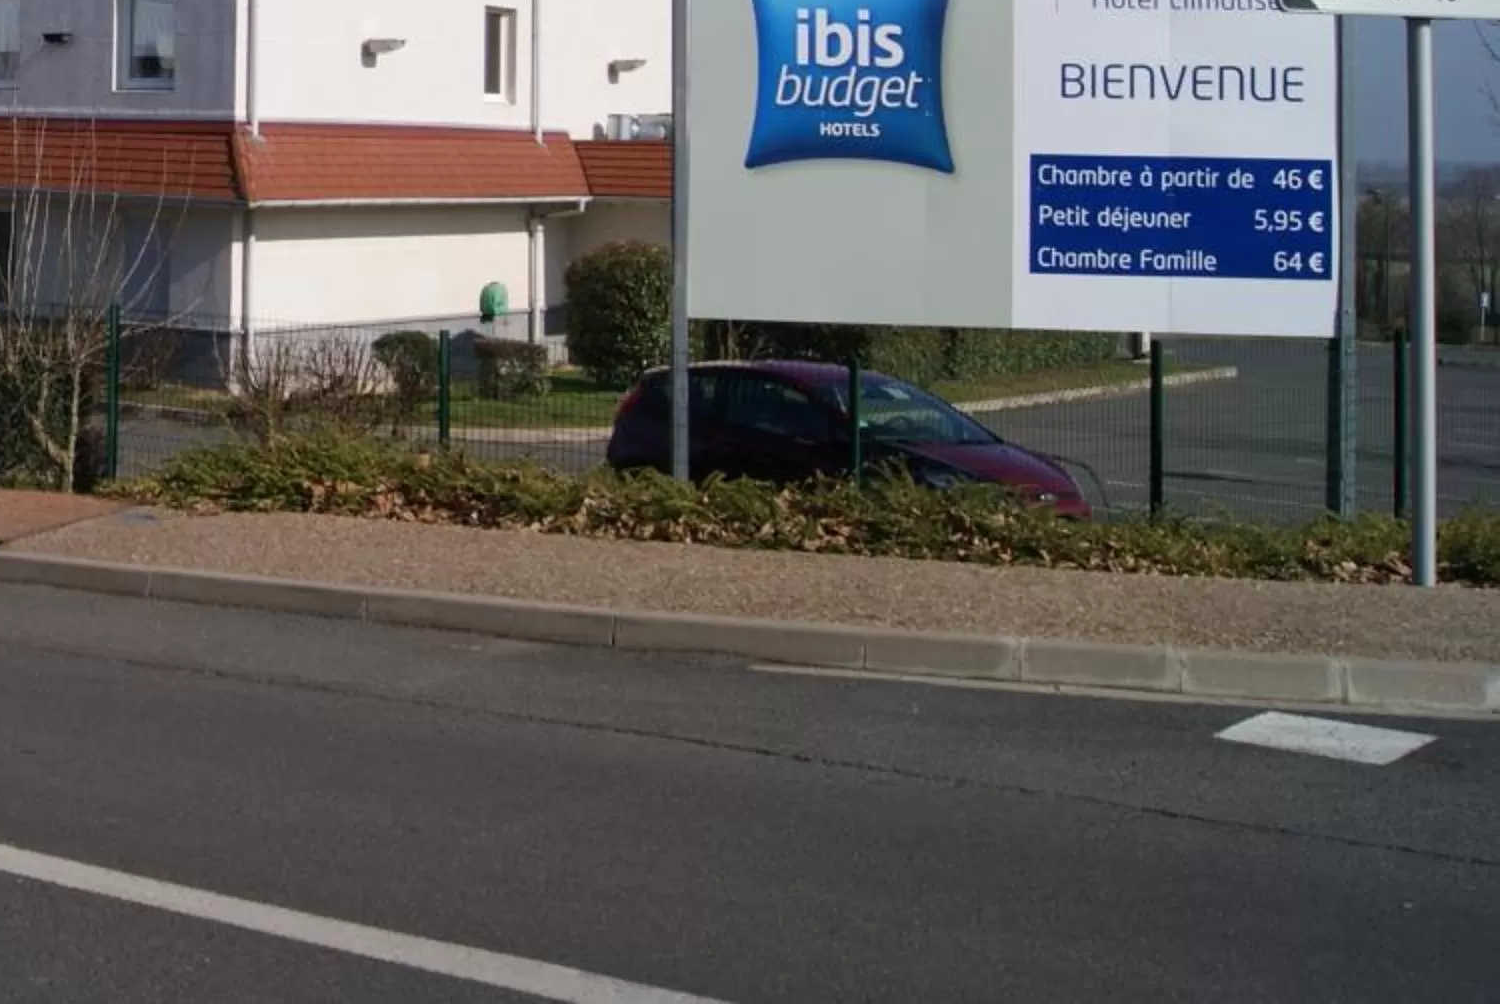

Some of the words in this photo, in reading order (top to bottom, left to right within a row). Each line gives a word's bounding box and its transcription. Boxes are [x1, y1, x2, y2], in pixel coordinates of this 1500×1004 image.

[796, 8, 905, 68] ibis
[775, 64, 923, 117] budget
[1060, 63, 1305, 103] BIENVENUE
[819, 123, 881, 137] HOTELS
[1038, 164, 1132, 187] Chambre
[1140, 165, 1153, 186] à
[1161, 167, 1220, 192] partir
[1227, 168, 1255, 189] de
[1272, 169, 1302, 189] 46
[1307, 169, 1323, 190] €
[1039, 205, 1090, 227] Petit
[1097, 207, 1192, 232] déjeuner
[1254, 209, 1303, 233] 5,95
[1308, 211, 1325, 232] €
[1037, 247, 1132, 270] Chambre
[1139, 249, 1218, 271] Famille
[1273, 251, 1302, 272] 64
[1308, 251, 1325, 273] €
